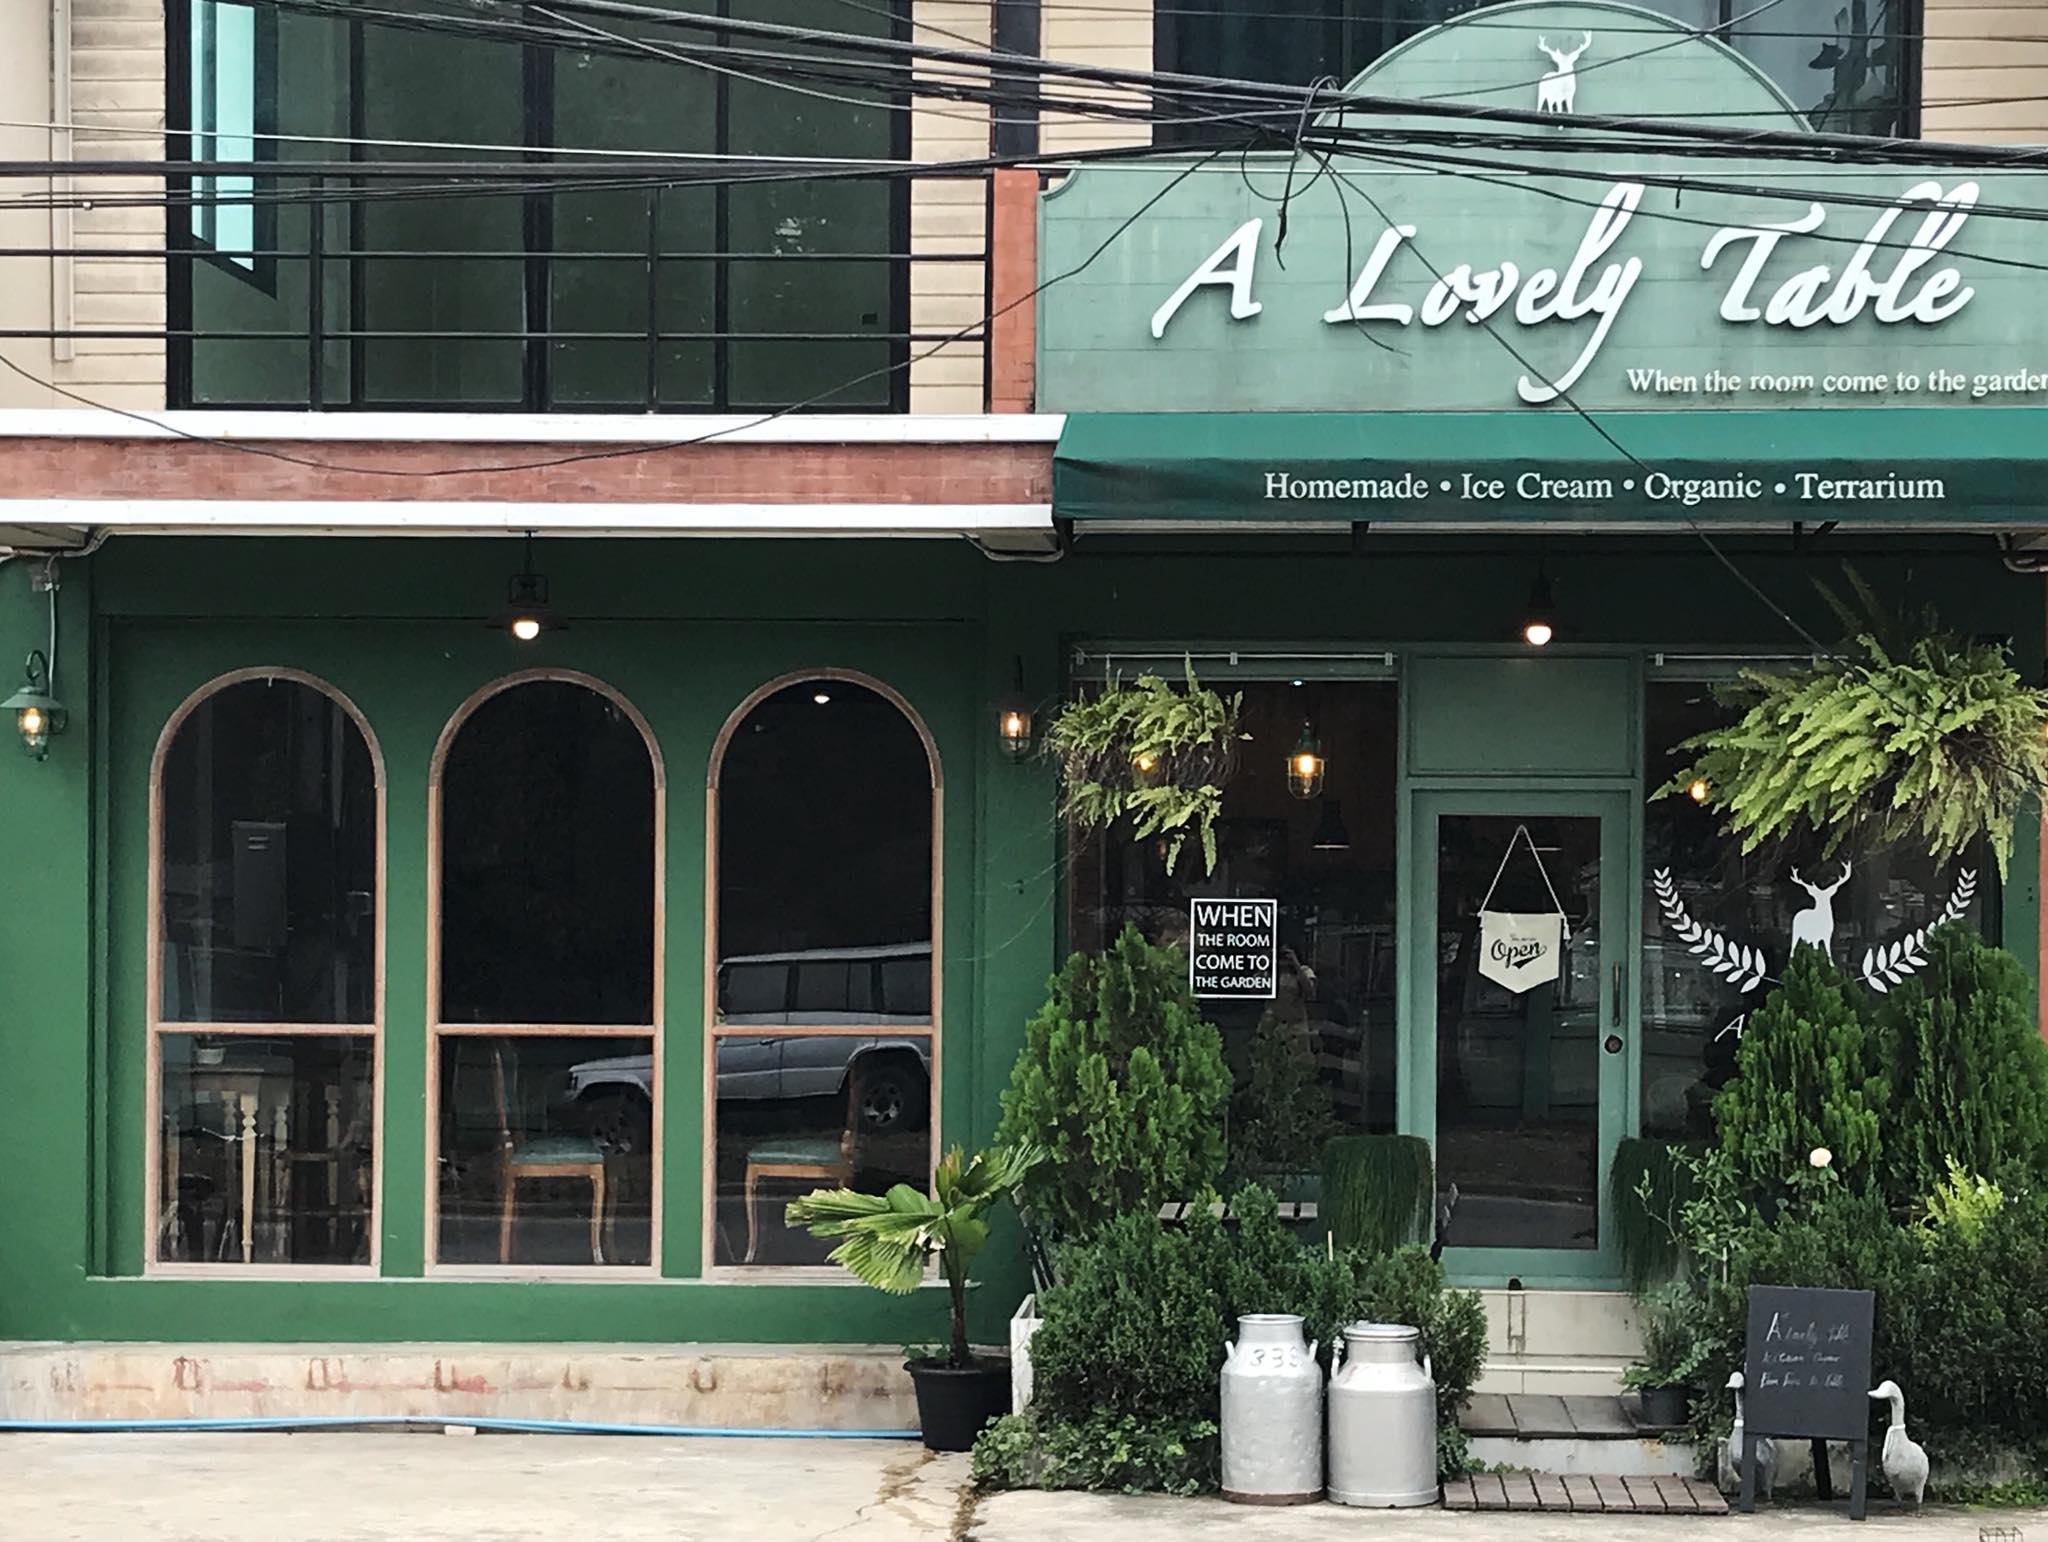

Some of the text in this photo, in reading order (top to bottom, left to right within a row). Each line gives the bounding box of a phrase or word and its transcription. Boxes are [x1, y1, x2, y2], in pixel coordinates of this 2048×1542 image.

[1151, 180, 1980, 403] A Lovely Table
[1626, 368, 1698, 393] When
[1705, 369, 1741, 392] the
[1749, 375, 1814, 391] room
[1822, 374, 1888, 392] come
[1896, 371, 1920, 391] to
[1928, 368, 1966, 392] the
[1264, 472, 1946, 505] Homemade Ice Cream Organic Terrarium
[1197, 904, 1272, 928] WHEN
[1197, 933, 1270, 948] THE ROOM
[1196, 954, 1270, 970] COME TO
[1490, 938, 1547, 970] Open
[1195, 975, 1271, 989] THE GARDEN
[1714, 1013, 1745, 1043] A
